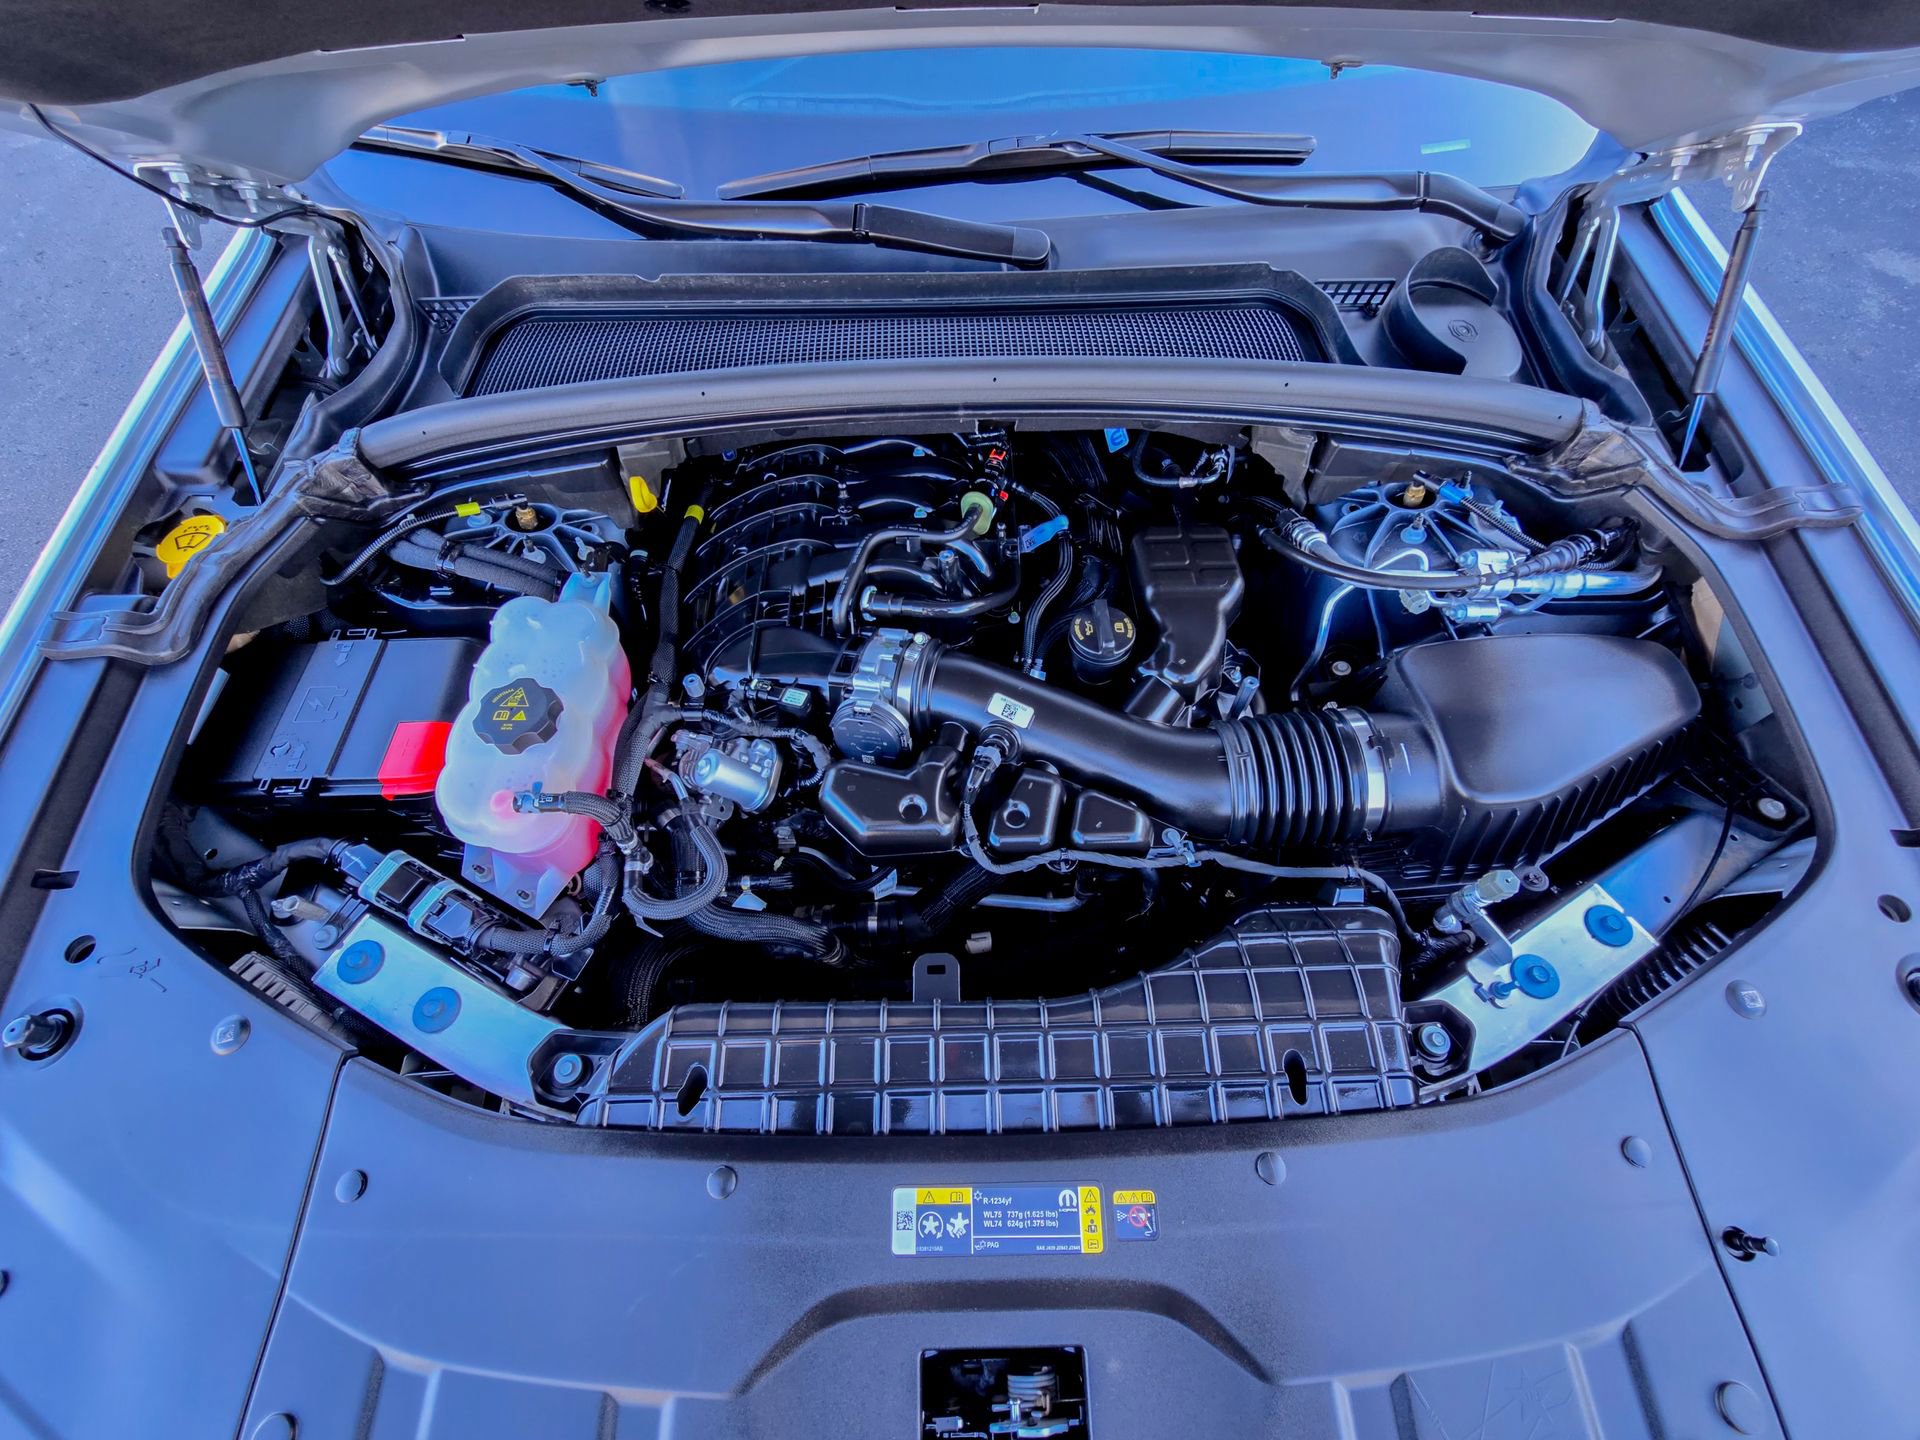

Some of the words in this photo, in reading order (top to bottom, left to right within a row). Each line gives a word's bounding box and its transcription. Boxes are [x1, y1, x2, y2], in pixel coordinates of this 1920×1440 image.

[983, 1197, 1012, 1206] R-1234yf
[1007, 1211, 1023, 1219] 737g
[1024, 1210, 1045, 1219] (1.625
[1045, 1210, 1059, 1219] lbs)
[983, 1220, 1002, 1228] WL74
[1007, 1220, 1023, 1229] 624g
[1024, 1220, 1045, 1229] (1.375
[1045, 1220, 1059, 1228] lbs)
[986, 1241, 999, 1249] PAG
